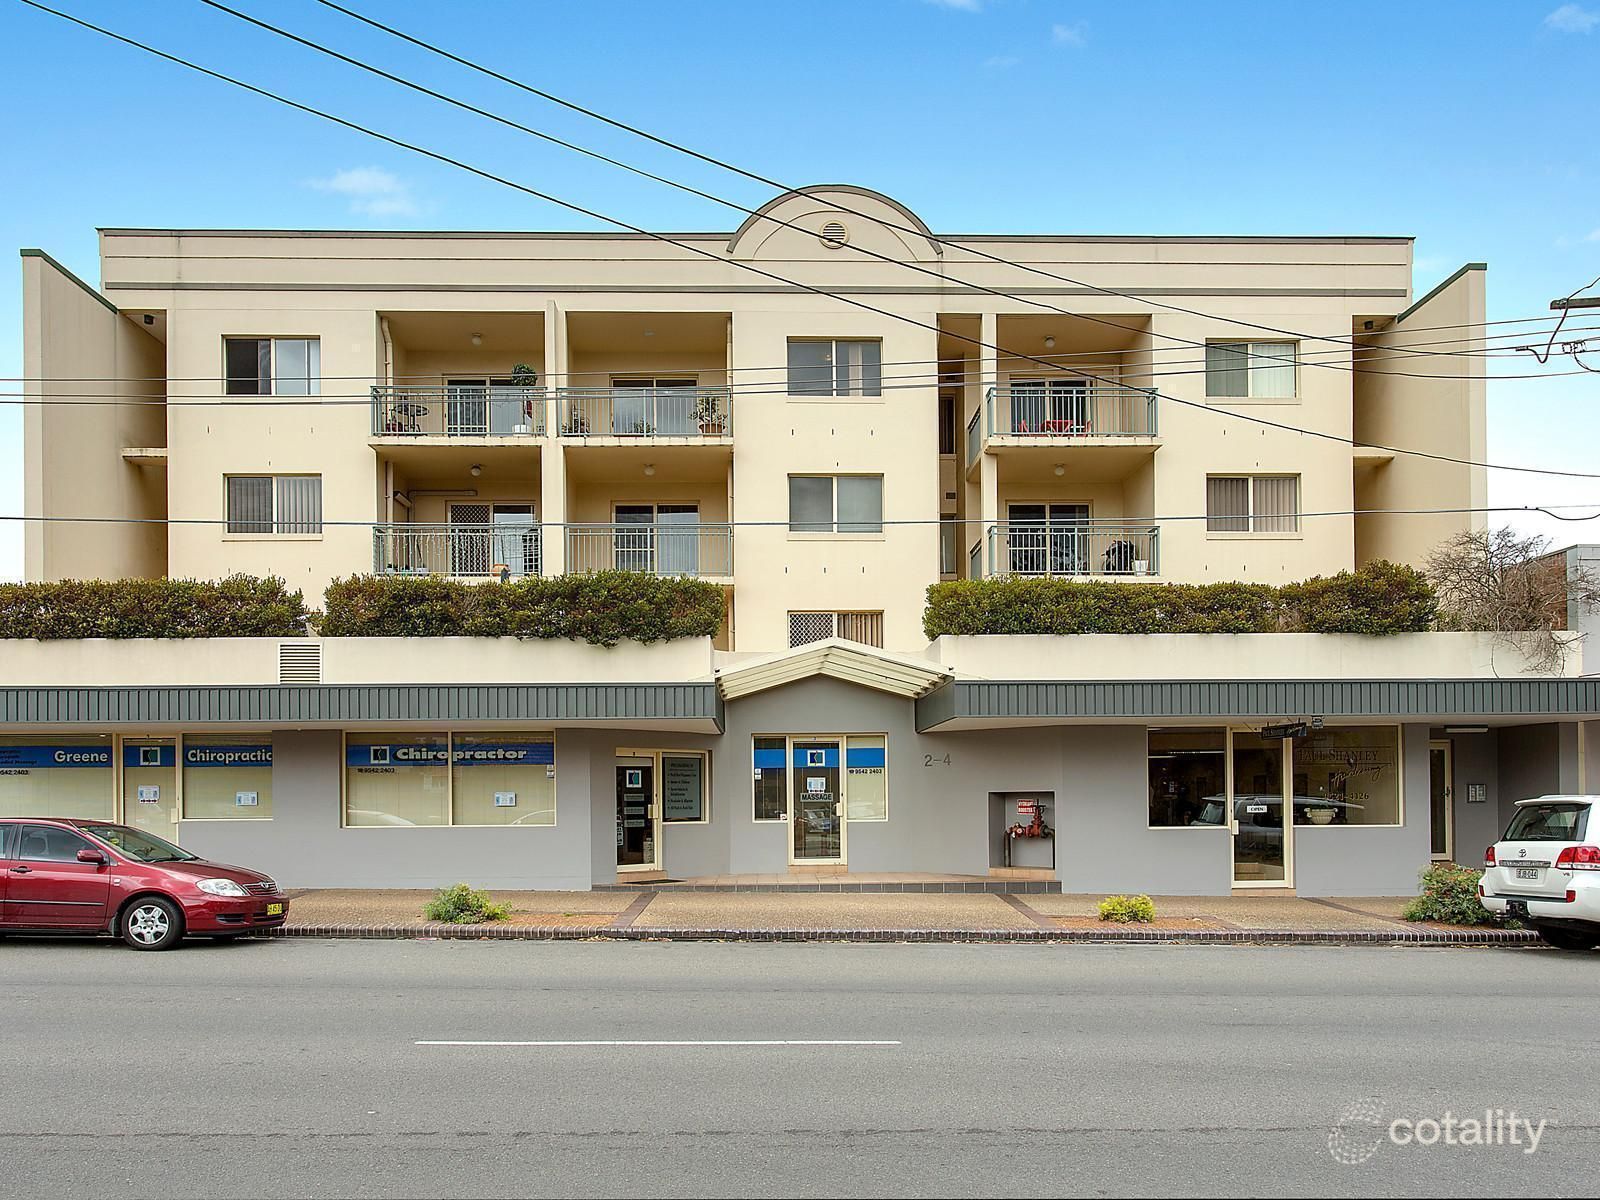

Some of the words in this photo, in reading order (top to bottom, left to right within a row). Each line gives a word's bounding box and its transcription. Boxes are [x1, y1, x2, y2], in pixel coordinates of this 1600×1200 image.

[54, 750, 108, 762] Greene
[187, 749, 272, 764] Chiropractic
[397, 748, 527, 761] Chiropractor
[924, 753, 952, 767] 2-4
[801, 793, 833, 801] MASSAGE
